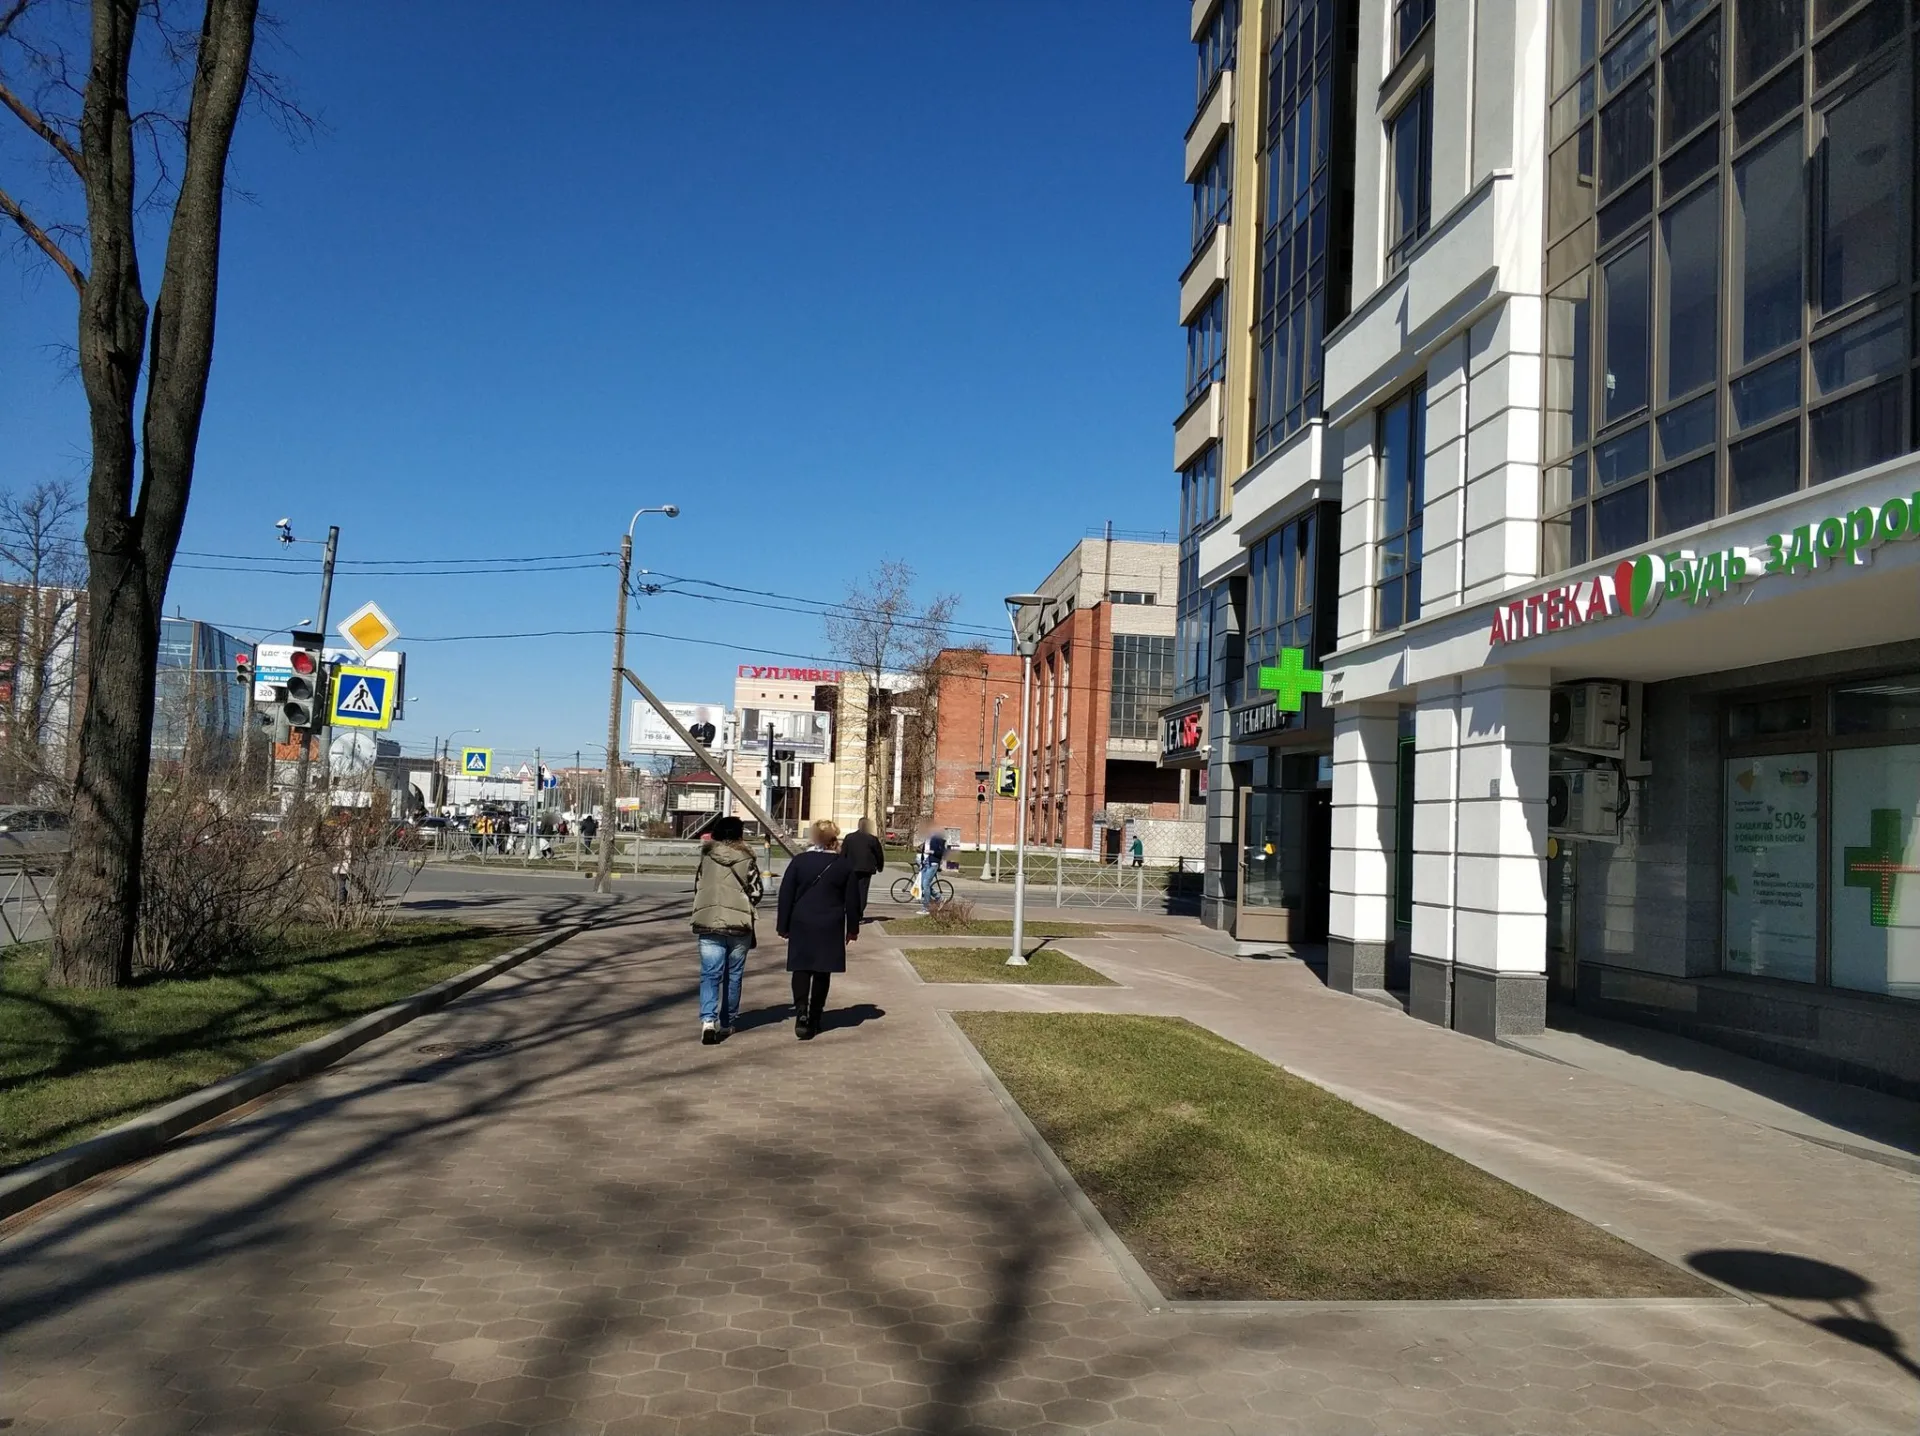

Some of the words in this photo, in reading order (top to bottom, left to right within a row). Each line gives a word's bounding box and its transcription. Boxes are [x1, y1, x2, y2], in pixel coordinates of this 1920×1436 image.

[1489, 577, 1610, 646] АПТЕКА
[1664, 547, 1748, 608] Будь
[1239, 703, 1277, 735] ПЕКАРНЯ
[1775, 811, 1807, 831] 50%
